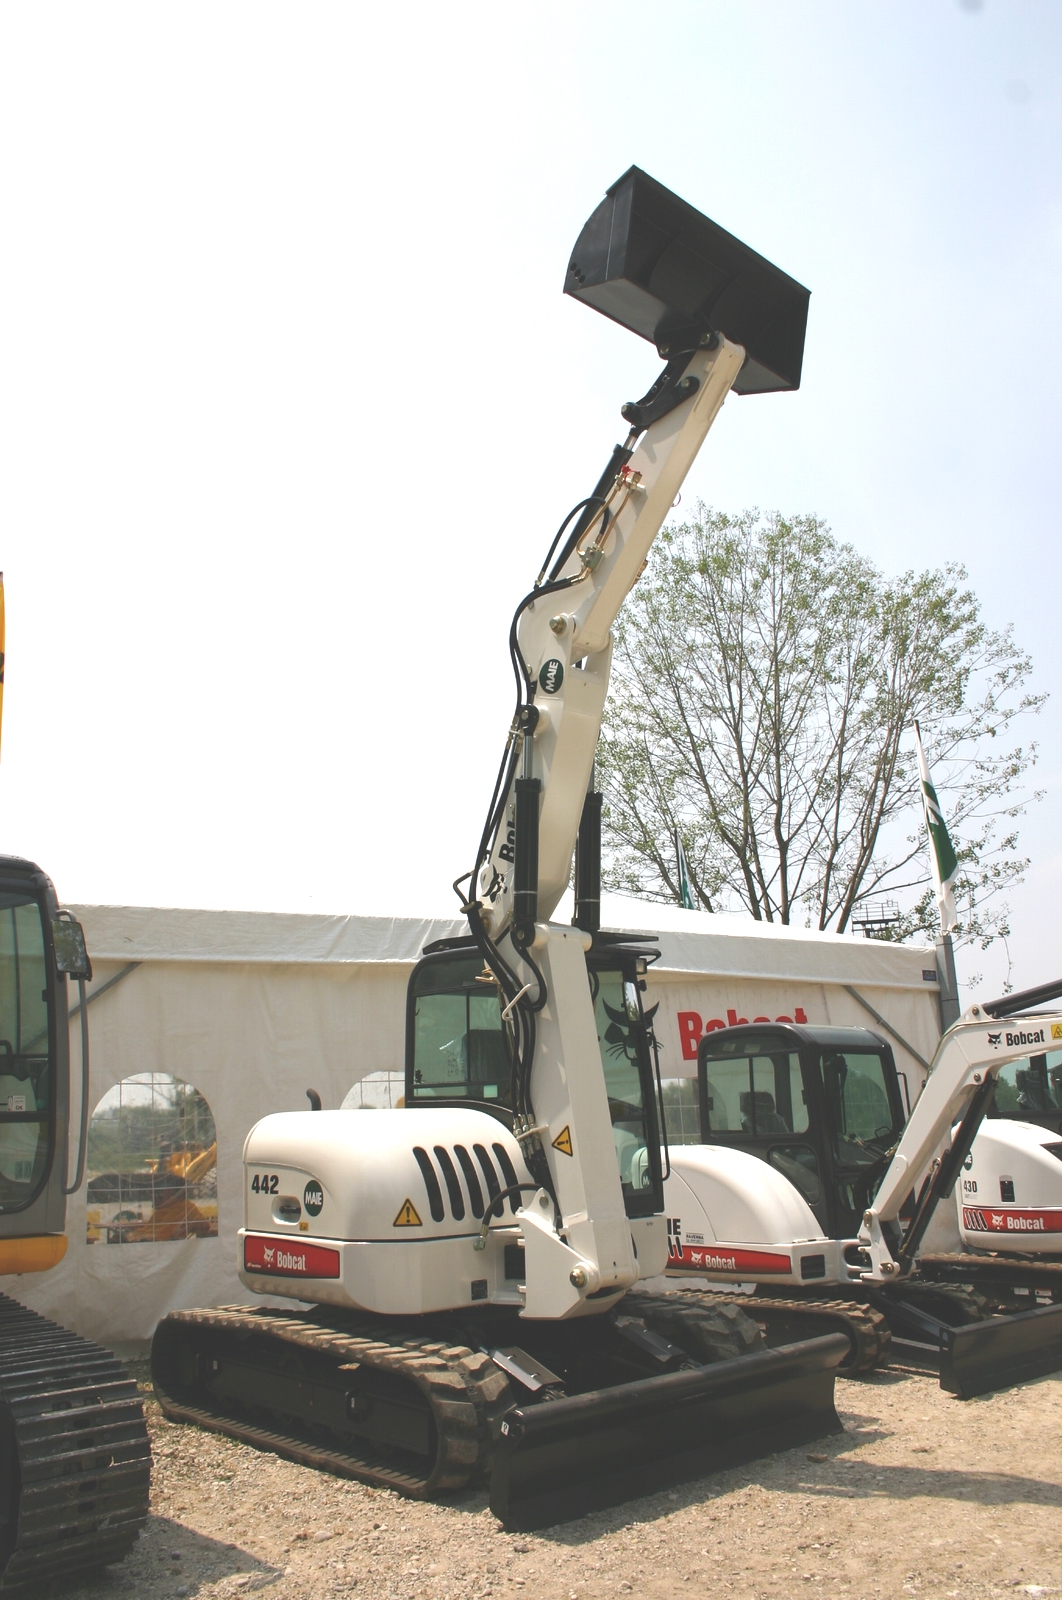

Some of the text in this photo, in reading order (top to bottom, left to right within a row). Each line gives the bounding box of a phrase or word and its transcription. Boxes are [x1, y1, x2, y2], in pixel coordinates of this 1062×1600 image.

[545, 660, 559, 692] MAIE
[1005, 1028, 1045, 1047] Bobcat
[251, 1174, 279, 1195] 442
[963, 1180, 978, 1193] 430
[304, 1191, 322, 1206] MAIE
[666, 1218, 681, 1235] IE
[1006, 1216, 1045, 1230] Bobcat
[277, 1250, 306, 1271] Bobcat
[705, 1254, 737, 1270] Bobcat
